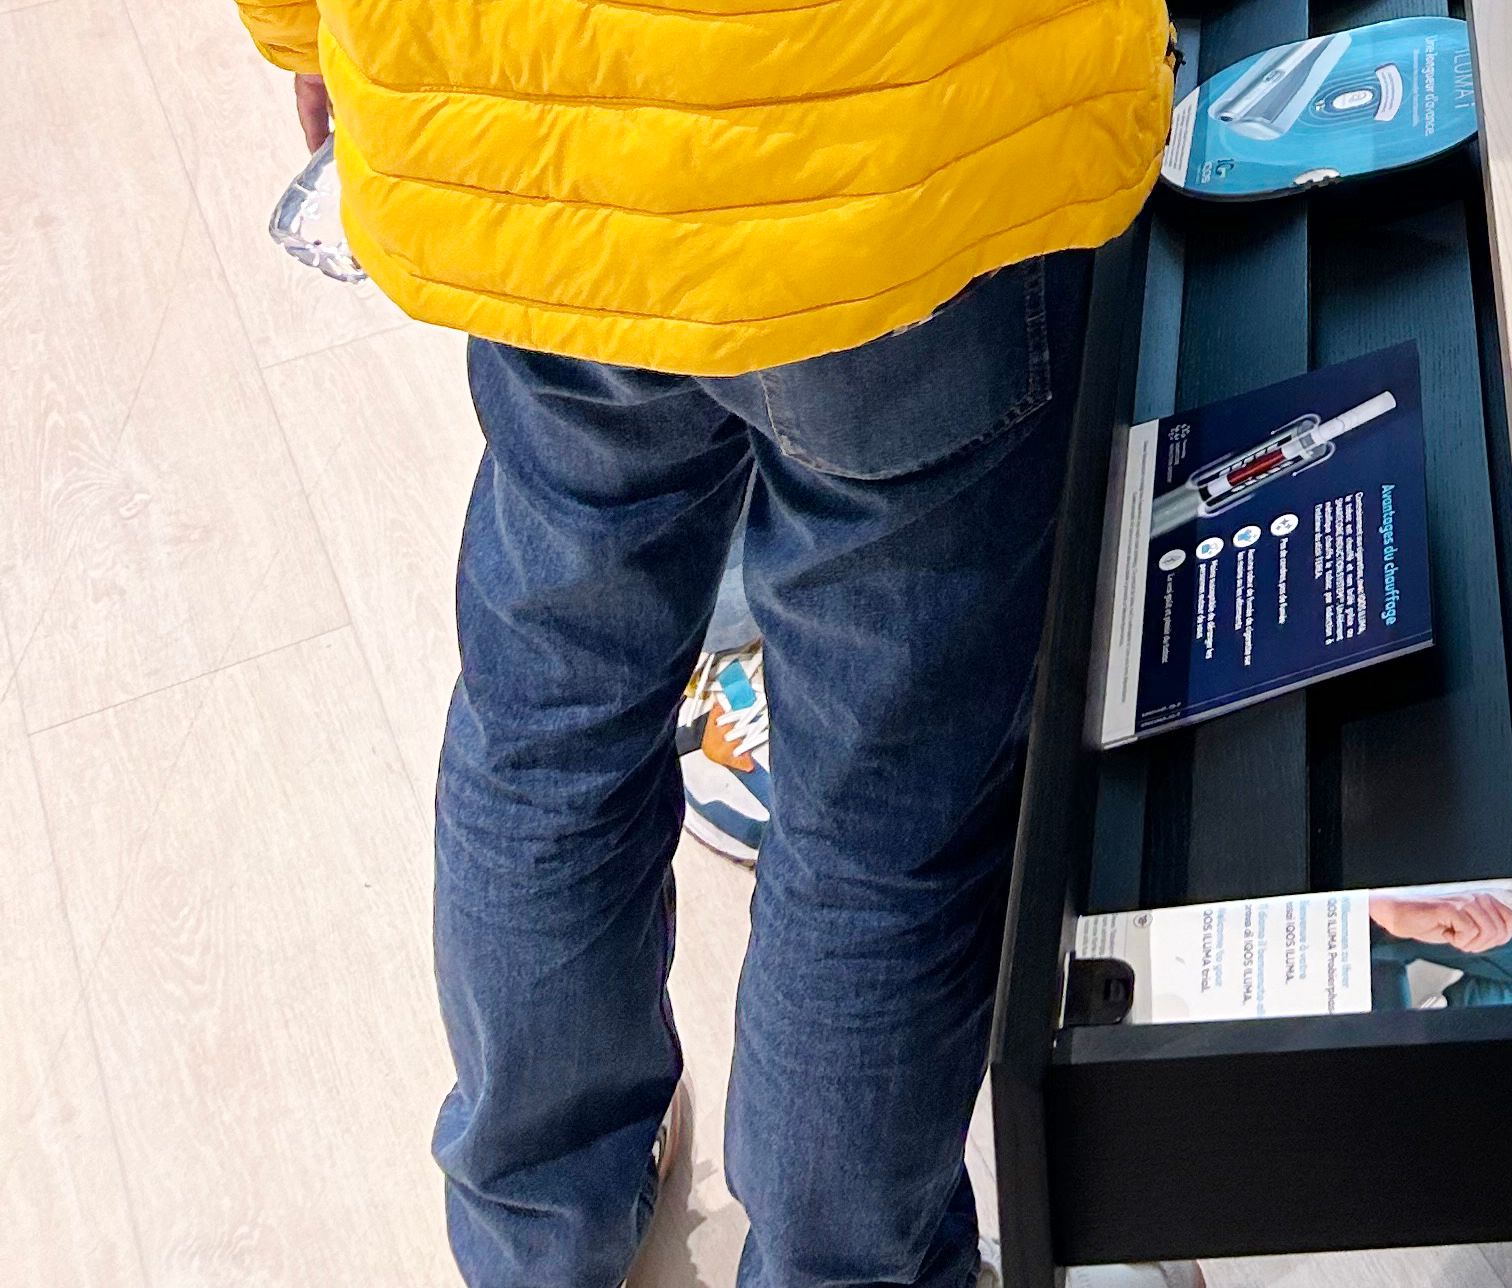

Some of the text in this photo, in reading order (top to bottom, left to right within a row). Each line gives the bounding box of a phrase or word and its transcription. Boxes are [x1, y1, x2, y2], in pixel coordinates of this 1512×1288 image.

[1378, 485, 1400, 626] Avantages du chauffage
[1286, 922, 1296, 948] IQOS
[1243, 940, 1253, 966] IQOS
